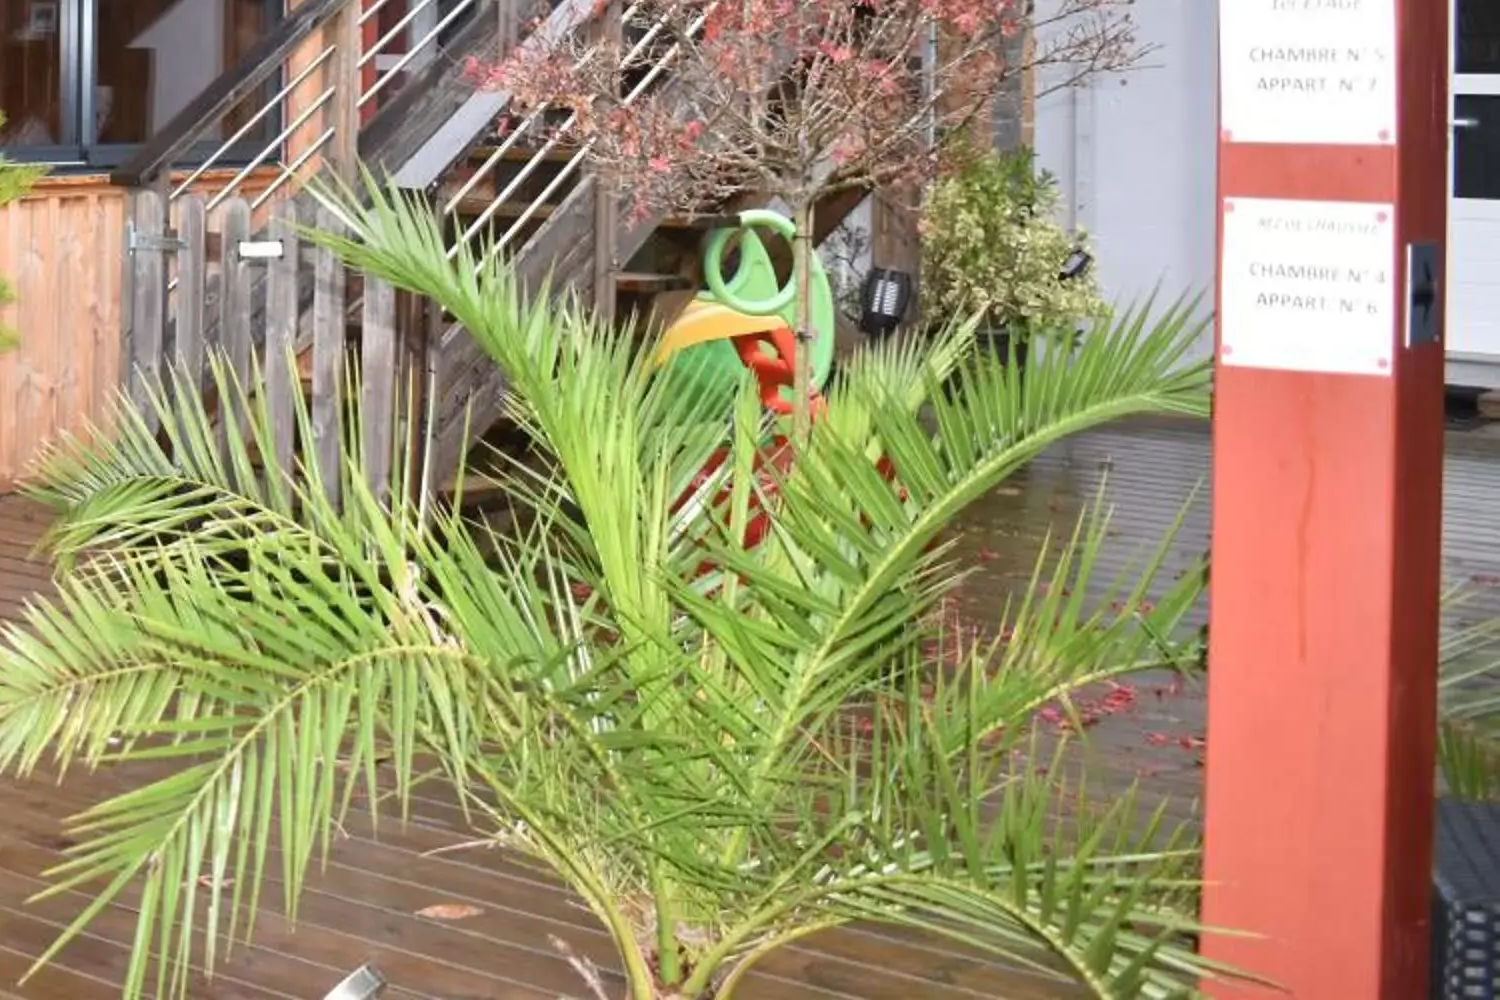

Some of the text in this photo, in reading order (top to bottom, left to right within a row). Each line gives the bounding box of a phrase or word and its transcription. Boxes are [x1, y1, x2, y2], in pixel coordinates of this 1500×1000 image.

[1249, 46, 1338, 63] CHAMBRE
[1249, 261, 1338, 281] CHAMBRE
[1375, 270, 1387, 284] 4
[1366, 302, 1379, 315] 6
